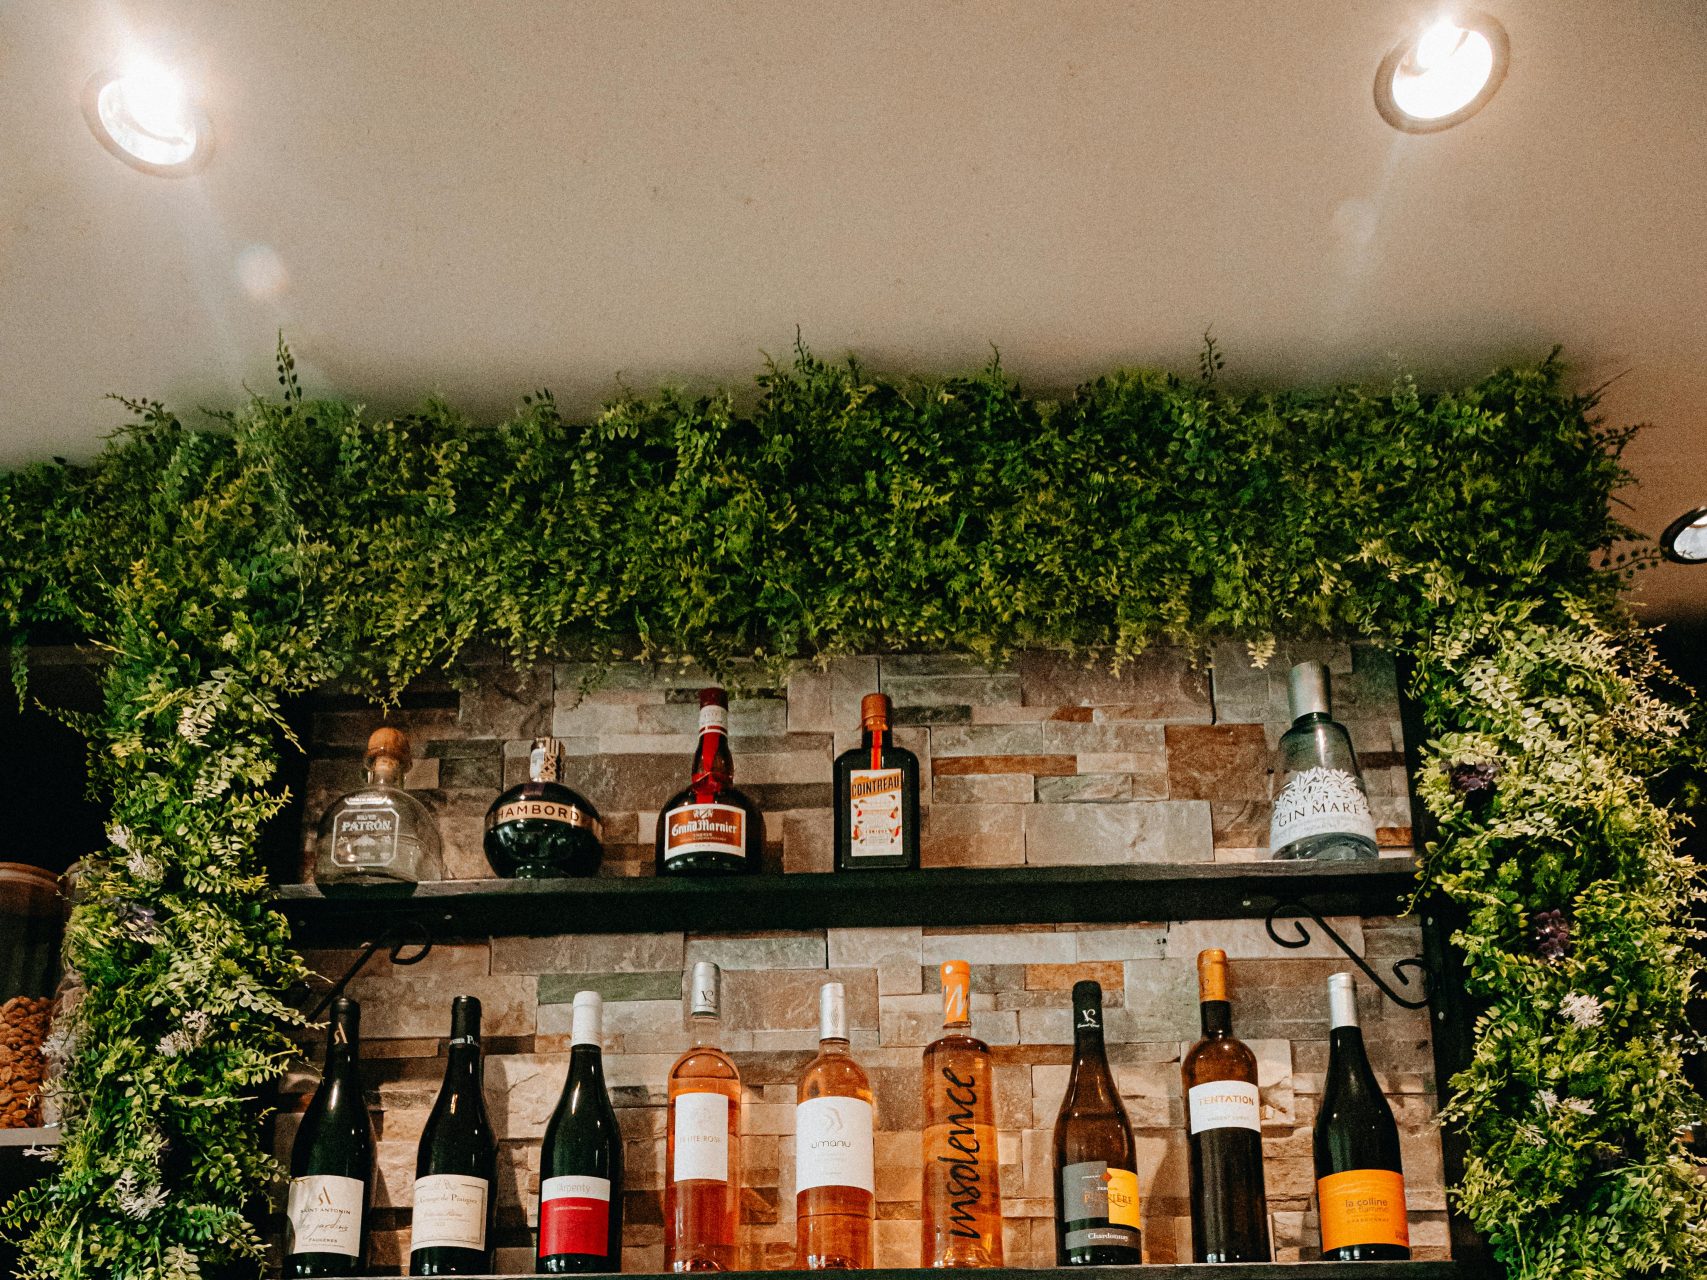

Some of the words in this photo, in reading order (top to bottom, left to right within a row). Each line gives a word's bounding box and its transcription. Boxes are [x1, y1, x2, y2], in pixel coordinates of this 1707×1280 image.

[852, 775, 900, 797] COINTREAU
[496, 804, 580, 822] HAMBORD
[1278, 806, 1306, 828] GIN
[1312, 802, 1361, 816] MARE
[1199, 1095, 1255, 1106] TENTATION
[1357, 1197, 1389, 1207] colline
